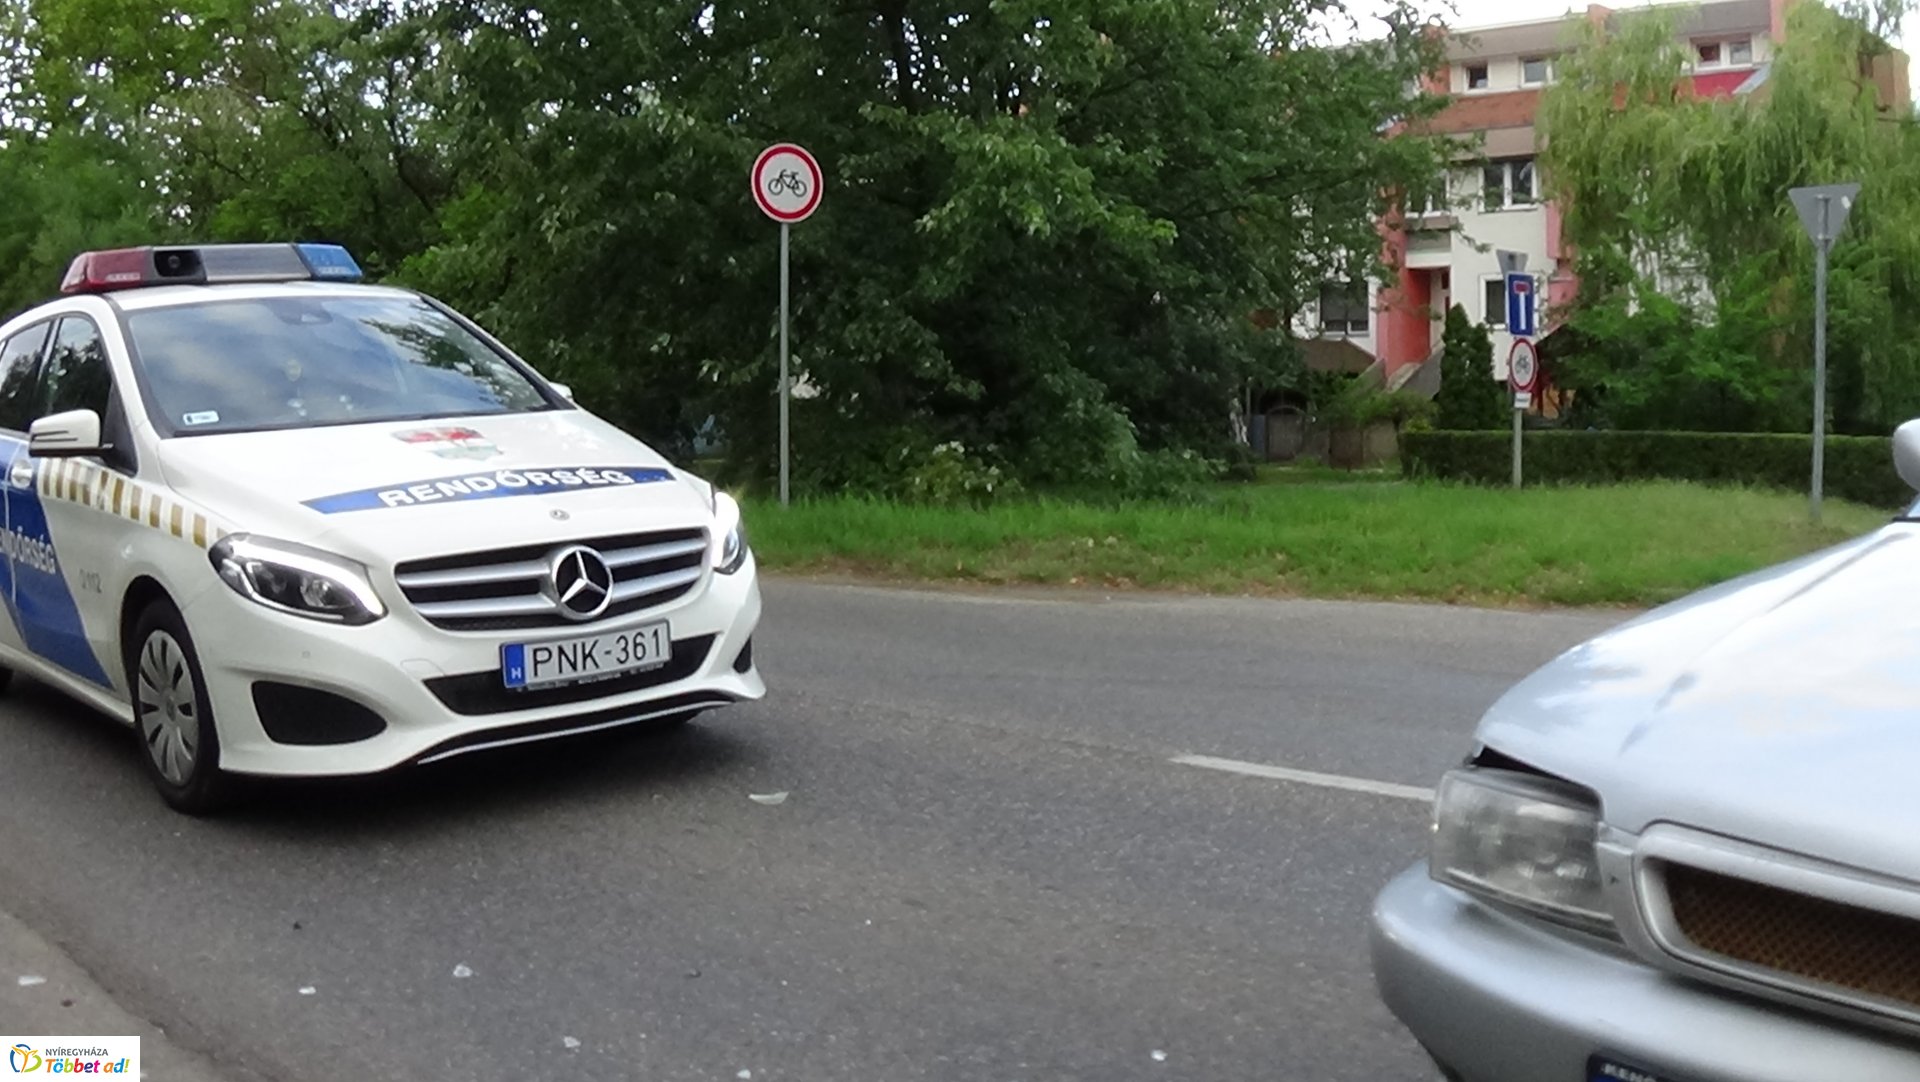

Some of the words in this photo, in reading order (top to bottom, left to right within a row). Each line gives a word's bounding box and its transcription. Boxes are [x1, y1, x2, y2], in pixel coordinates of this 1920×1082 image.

[378, 467, 635, 507] RENDŐRSÉG
[532, 628, 660, 677] PNK-361
[511, 667, 522, 679] H
